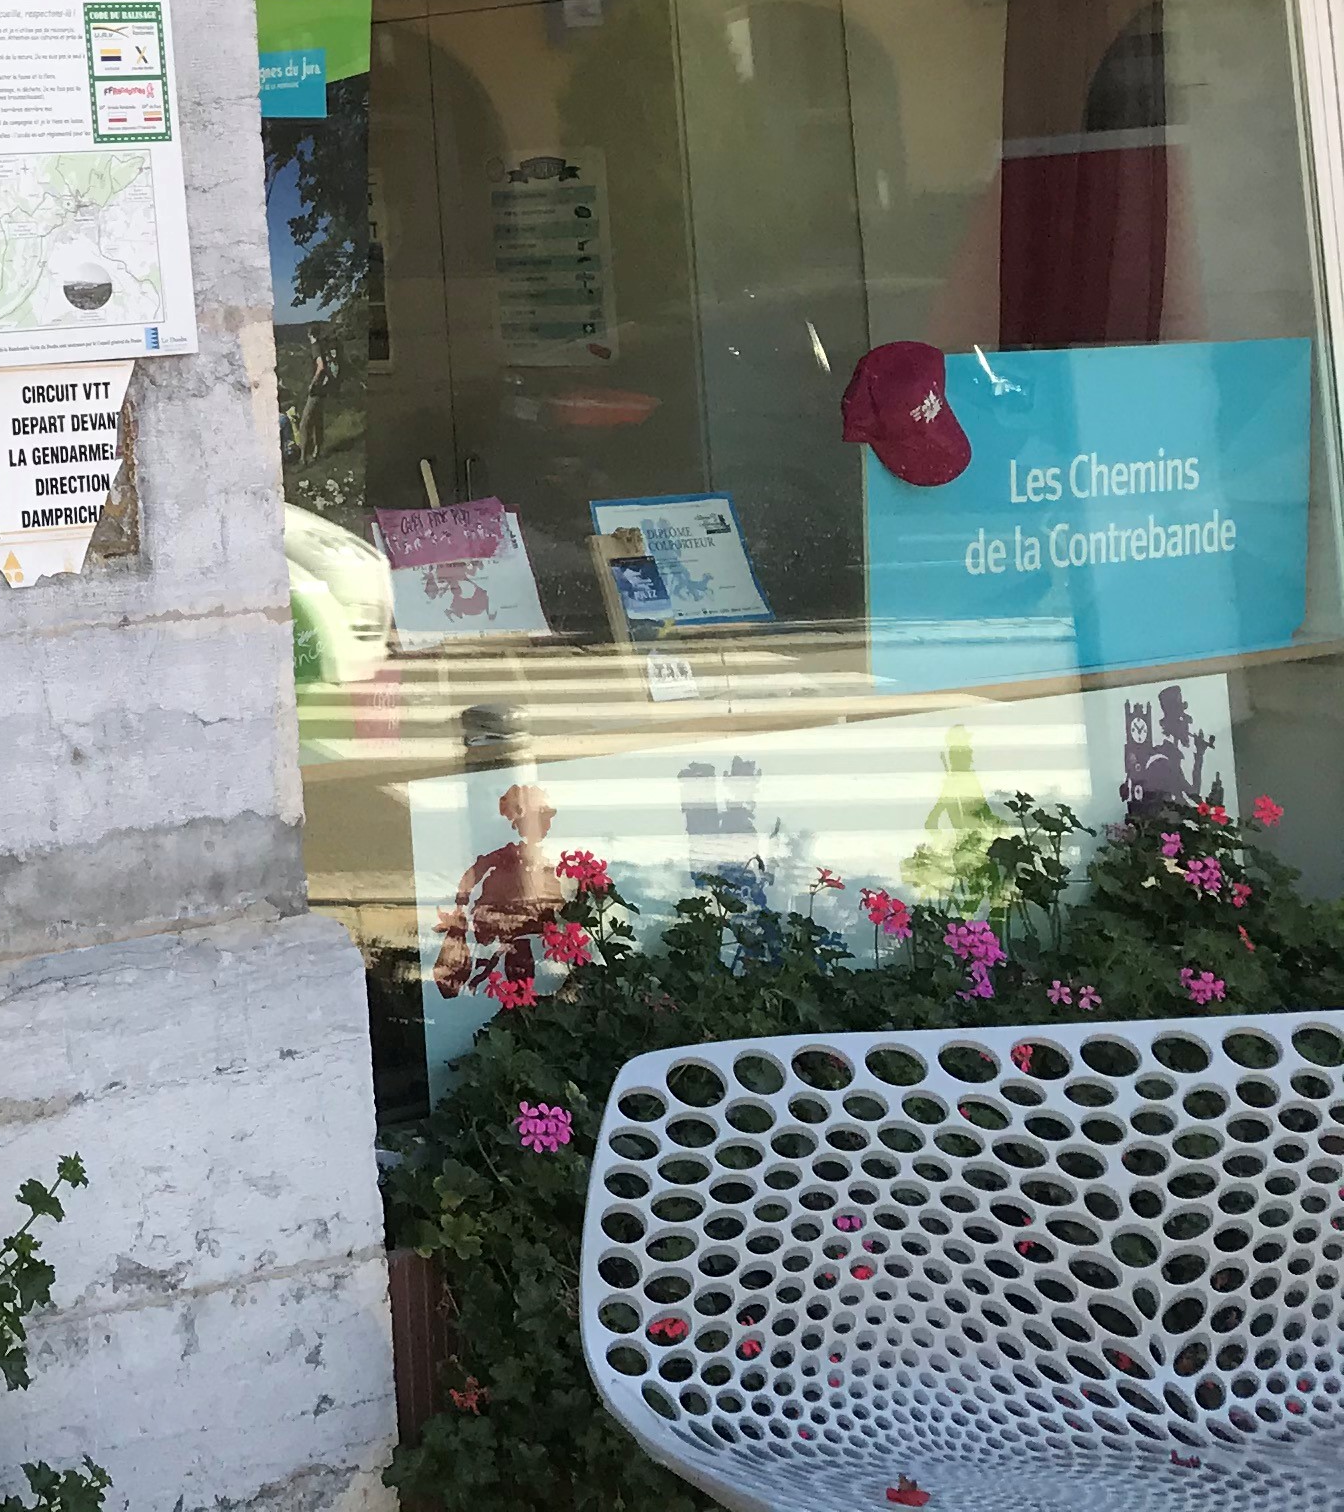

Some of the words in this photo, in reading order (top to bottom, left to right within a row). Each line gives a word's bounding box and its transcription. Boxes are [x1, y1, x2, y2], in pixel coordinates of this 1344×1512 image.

[89, 11, 109, 20] CODE
[109, 11, 120, 19] DU
[121, 11, 157, 20] BALISAGE
[285, 57, 299, 76] du
[301, 56, 322, 80] Jura
[22, 383, 78, 404] CIRCUIT
[83, 381, 111, 400] VTT
[12, 414, 65, 436] DEPART
[8, 448, 27, 467] LA
[35, 473, 110, 496] DIRECTION
[1010, 458, 1062, 504] Les
[1068, 447, 1200, 499] Chemins
[648, 537, 716, 552] COLPORTEUR
[964, 527, 1007, 575] de
[1014, 523, 1042, 572] la
[1048, 508, 1237, 569] Contrebande
